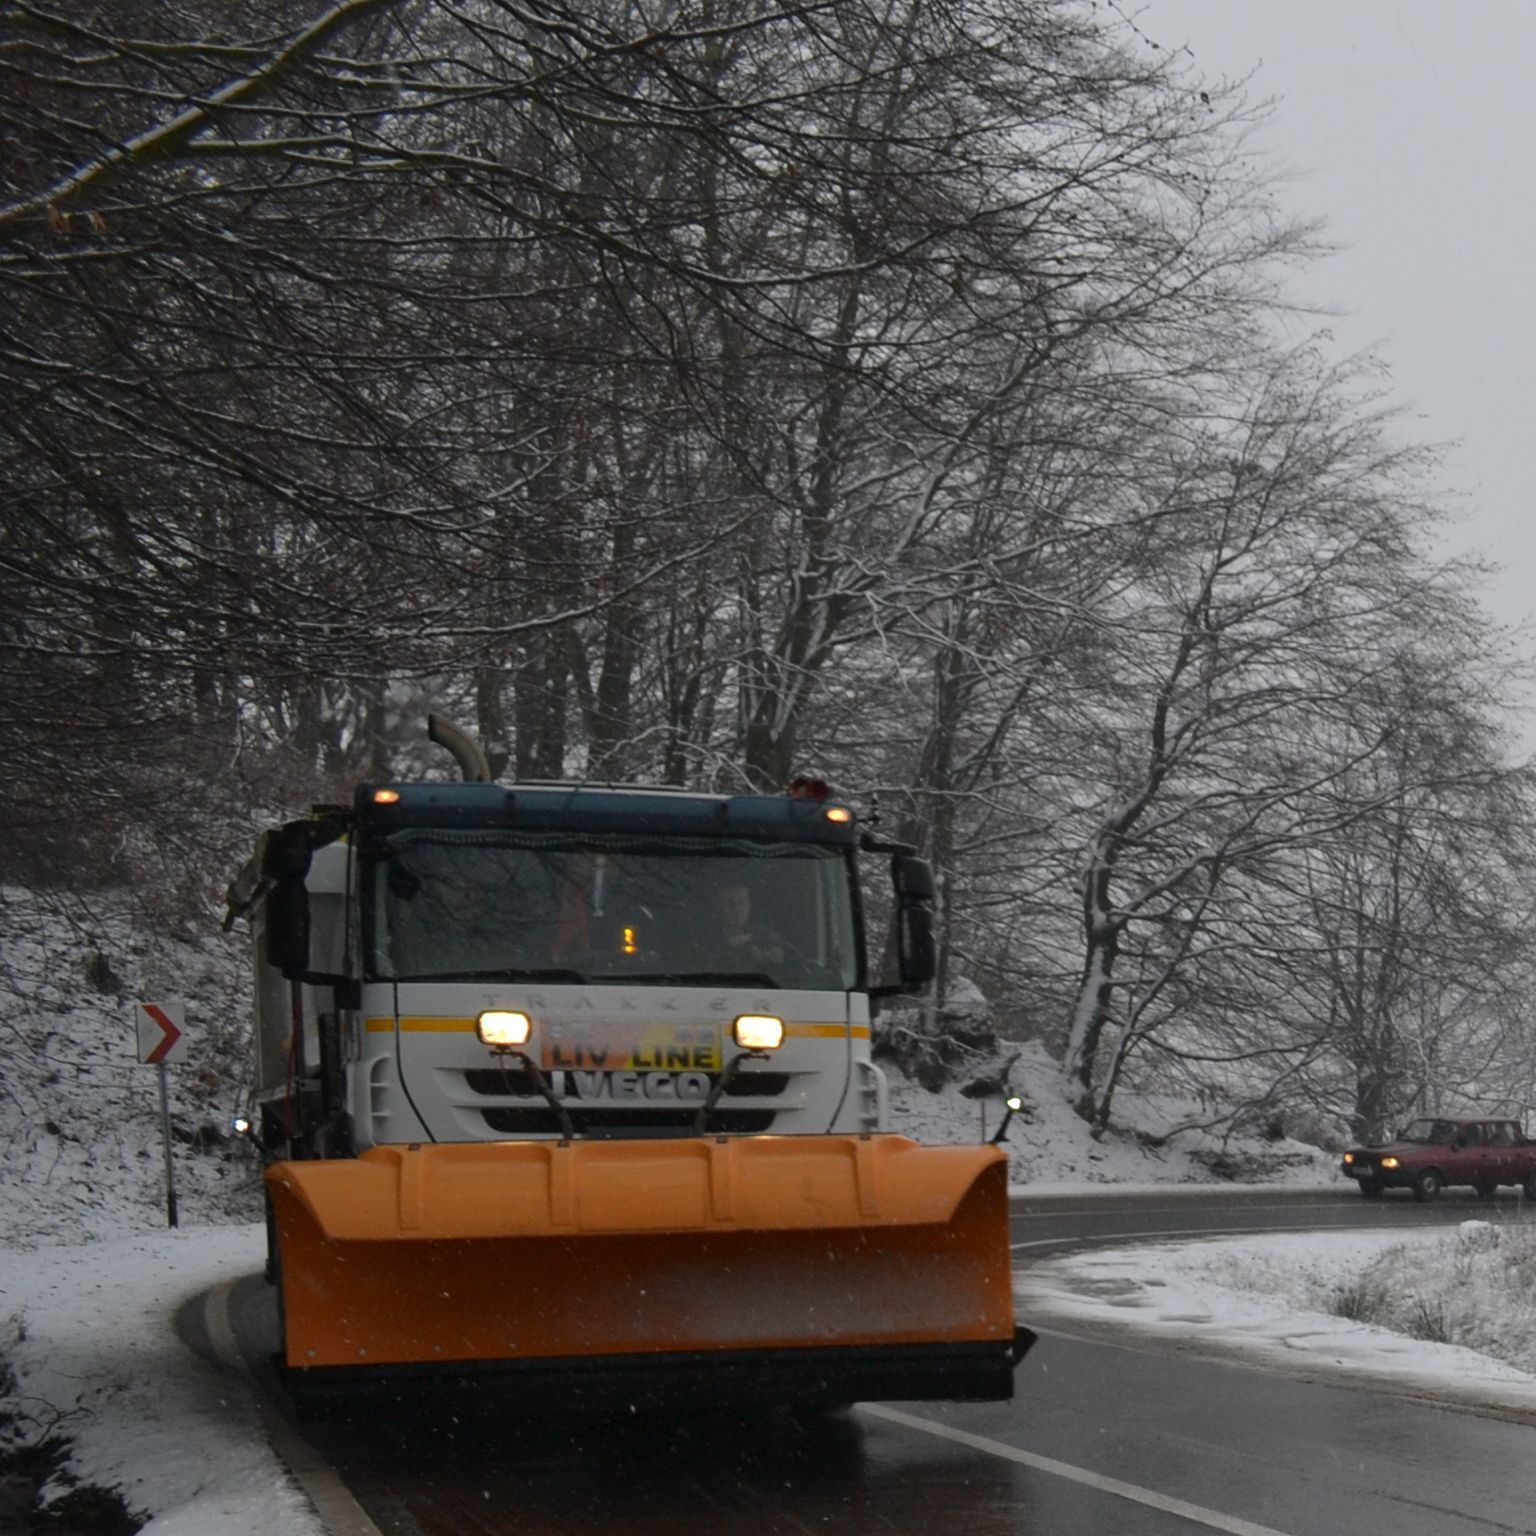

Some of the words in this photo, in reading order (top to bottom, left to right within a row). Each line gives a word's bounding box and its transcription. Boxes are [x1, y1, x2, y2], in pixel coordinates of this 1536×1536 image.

[482, 993, 772, 1012] TRAKKER
[631, 1044, 713, 1068] LINE
[551, 1070, 712, 1100] IVECO
